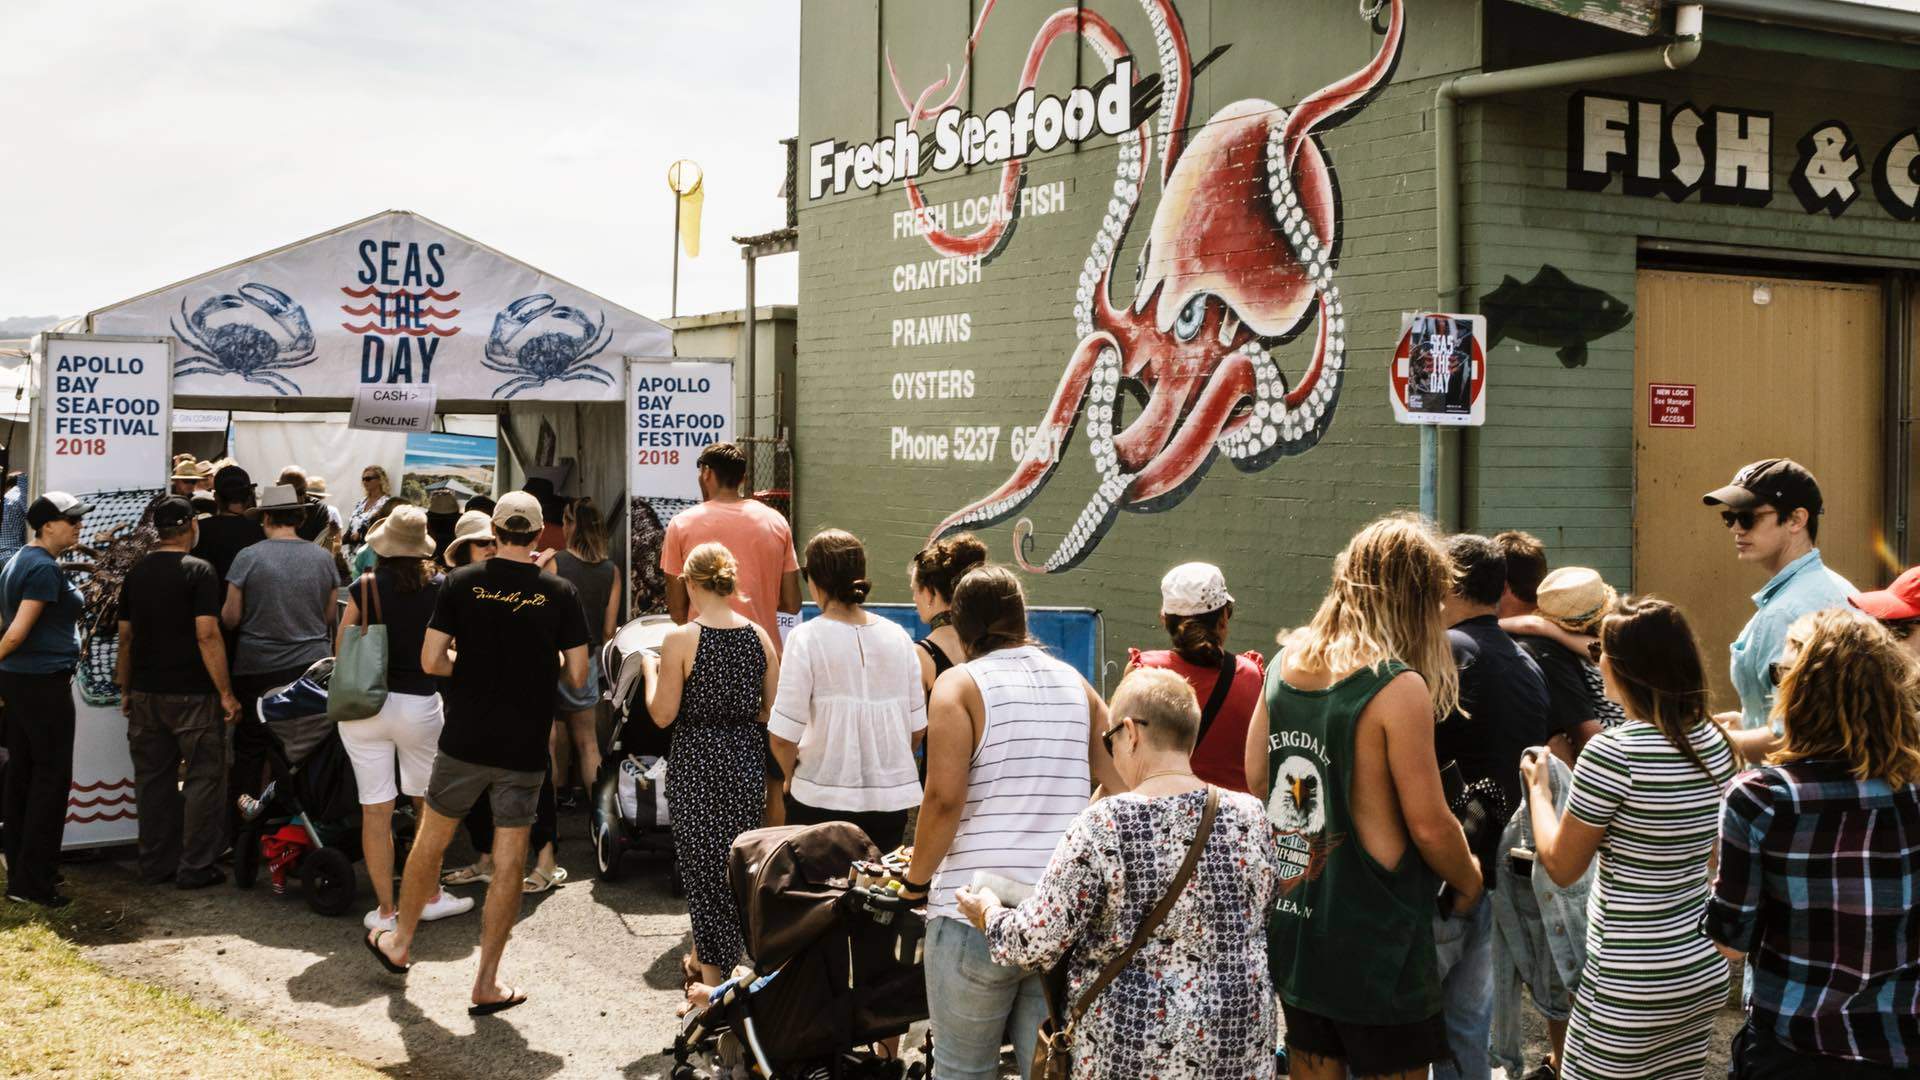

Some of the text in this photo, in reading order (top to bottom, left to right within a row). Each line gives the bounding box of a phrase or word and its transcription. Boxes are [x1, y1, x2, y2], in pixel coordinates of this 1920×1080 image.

[809, 56, 1133, 200] Fresh Seafood
[1581, 94, 1771, 191] FISH
[1804, 125, 1859, 203] &
[893, 181, 1065, 240] FRESH LOCAL FISH
[358, 239, 445, 288] SEAS
[892, 253, 982, 293] CRAYFISH
[375, 291, 428, 329] THE
[892, 313, 972, 346] PRAWNS
[1430, 334, 1454, 355] SEAS
[56, 355, 144, 375] APOLLO
[360, 334, 440, 384] DAY
[1431, 354, 1451, 374] THE
[56, 376, 99, 393] BAY
[637, 377, 711, 393] APOLLO
[892, 370, 975, 400] OYSTERS
[1430, 373, 1451, 393] DAY
[373, 390, 408, 401] CASH
[638, 396, 673, 410] BAY
[1654, 397, 1691, 407] See Manager
[56, 396, 160, 416] SEAFOOD
[56, 417, 160, 436] FESTIVAL
[638, 414, 725, 429] SEAFOOD
[56, 438, 106, 456] 2018
[891, 426, 949, 460] Phone
[953, 426, 1000, 461] 5237
[638, 450, 680, 465] 2018
[1267, 730, 1331, 766] ERGDAL
[1280, 834, 1308, 850] MOTOR
